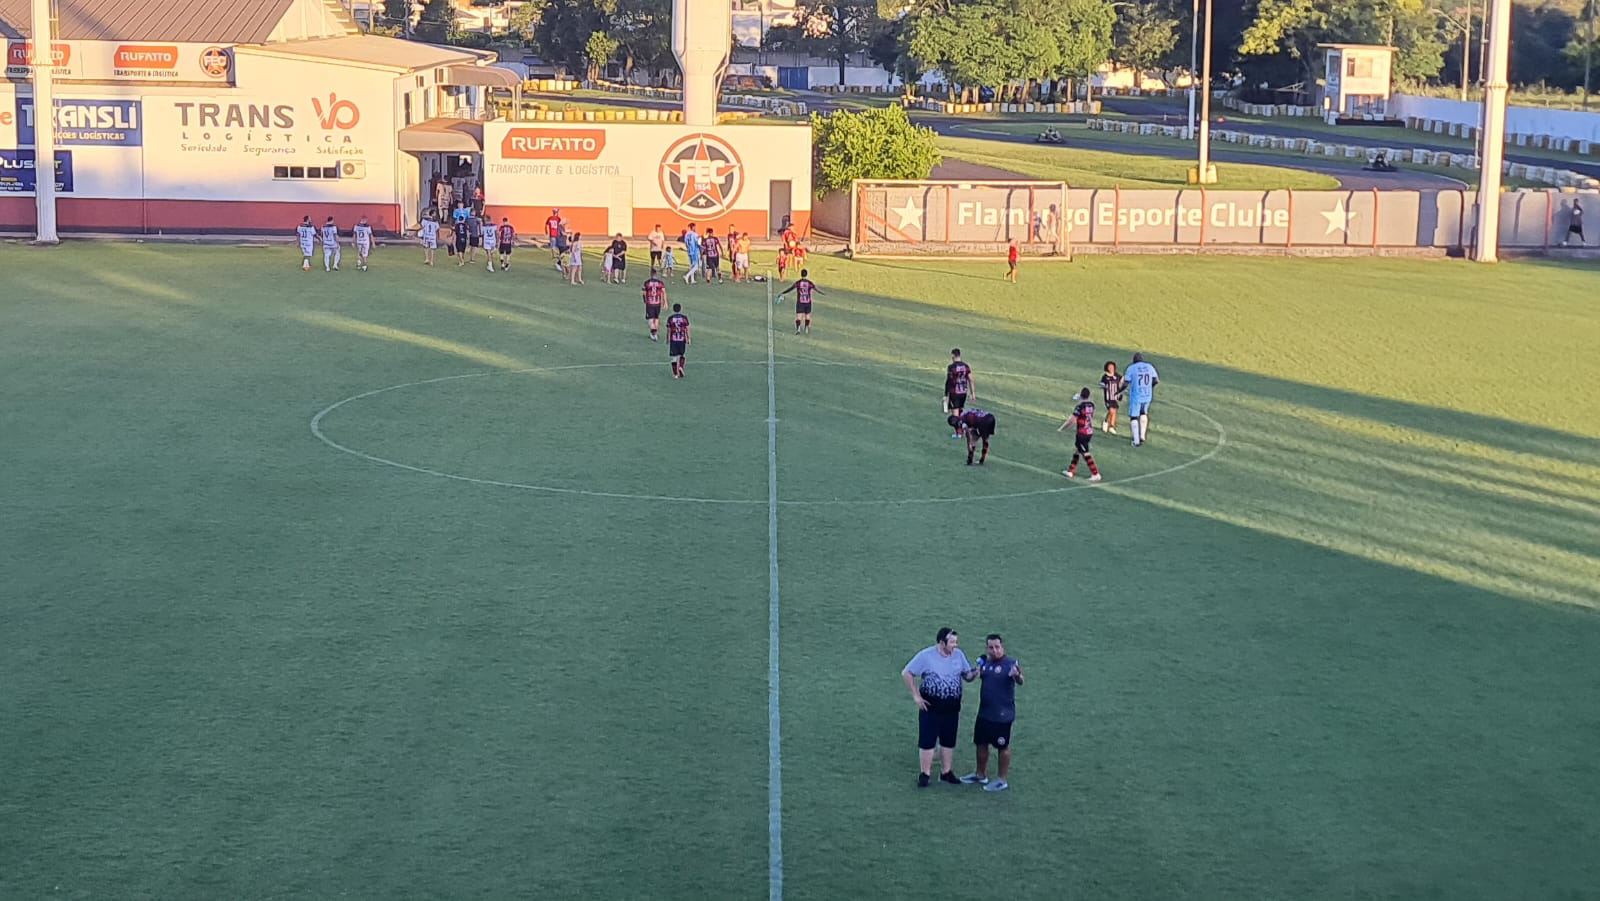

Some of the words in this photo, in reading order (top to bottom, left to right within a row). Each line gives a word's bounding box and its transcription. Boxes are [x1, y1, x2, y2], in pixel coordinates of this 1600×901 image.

[120, 52, 172, 62] RUFATTO
[174, 102, 294, 129] TRANS
[511, 136, 596, 152] RUFATTO
[490, 163, 552, 175] TRANSPORTE
[680, 159, 726, 184] FEC
[1098, 202, 1202, 232] Esporte
[1210, 201, 1288, 227] Clube
[1138, 373, 1149, 386] 70
